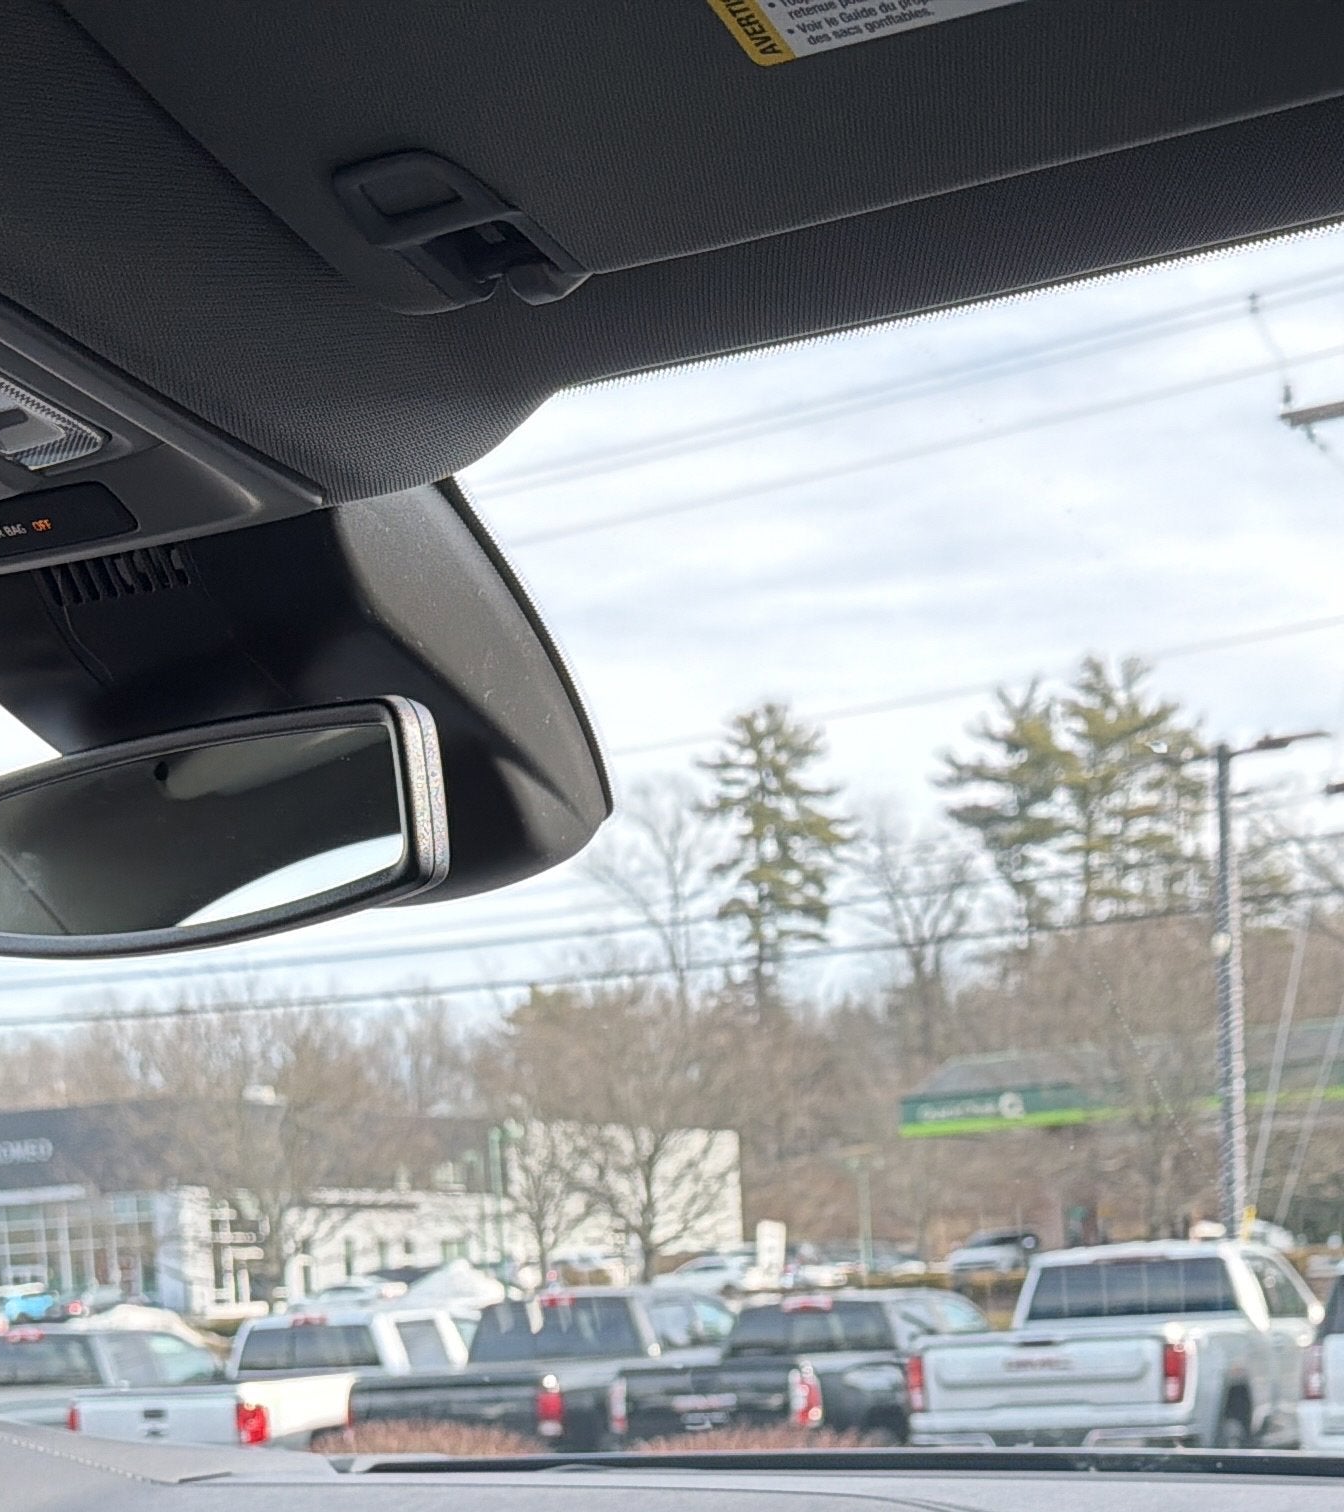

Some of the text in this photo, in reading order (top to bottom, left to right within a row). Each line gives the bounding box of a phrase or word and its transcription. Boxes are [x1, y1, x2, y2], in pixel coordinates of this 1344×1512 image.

[721, 0, 784, 54] AVERTI
[796, 20, 823, 34] Voir
[825, 17, 839, 27] le
[840, 7, 879, 23] Guide
[880, 3, 898, 14] du
[808, 33, 832, 46] des
[3, 524, 27, 537] BAG
[31, 518, 52, 532] OFF
